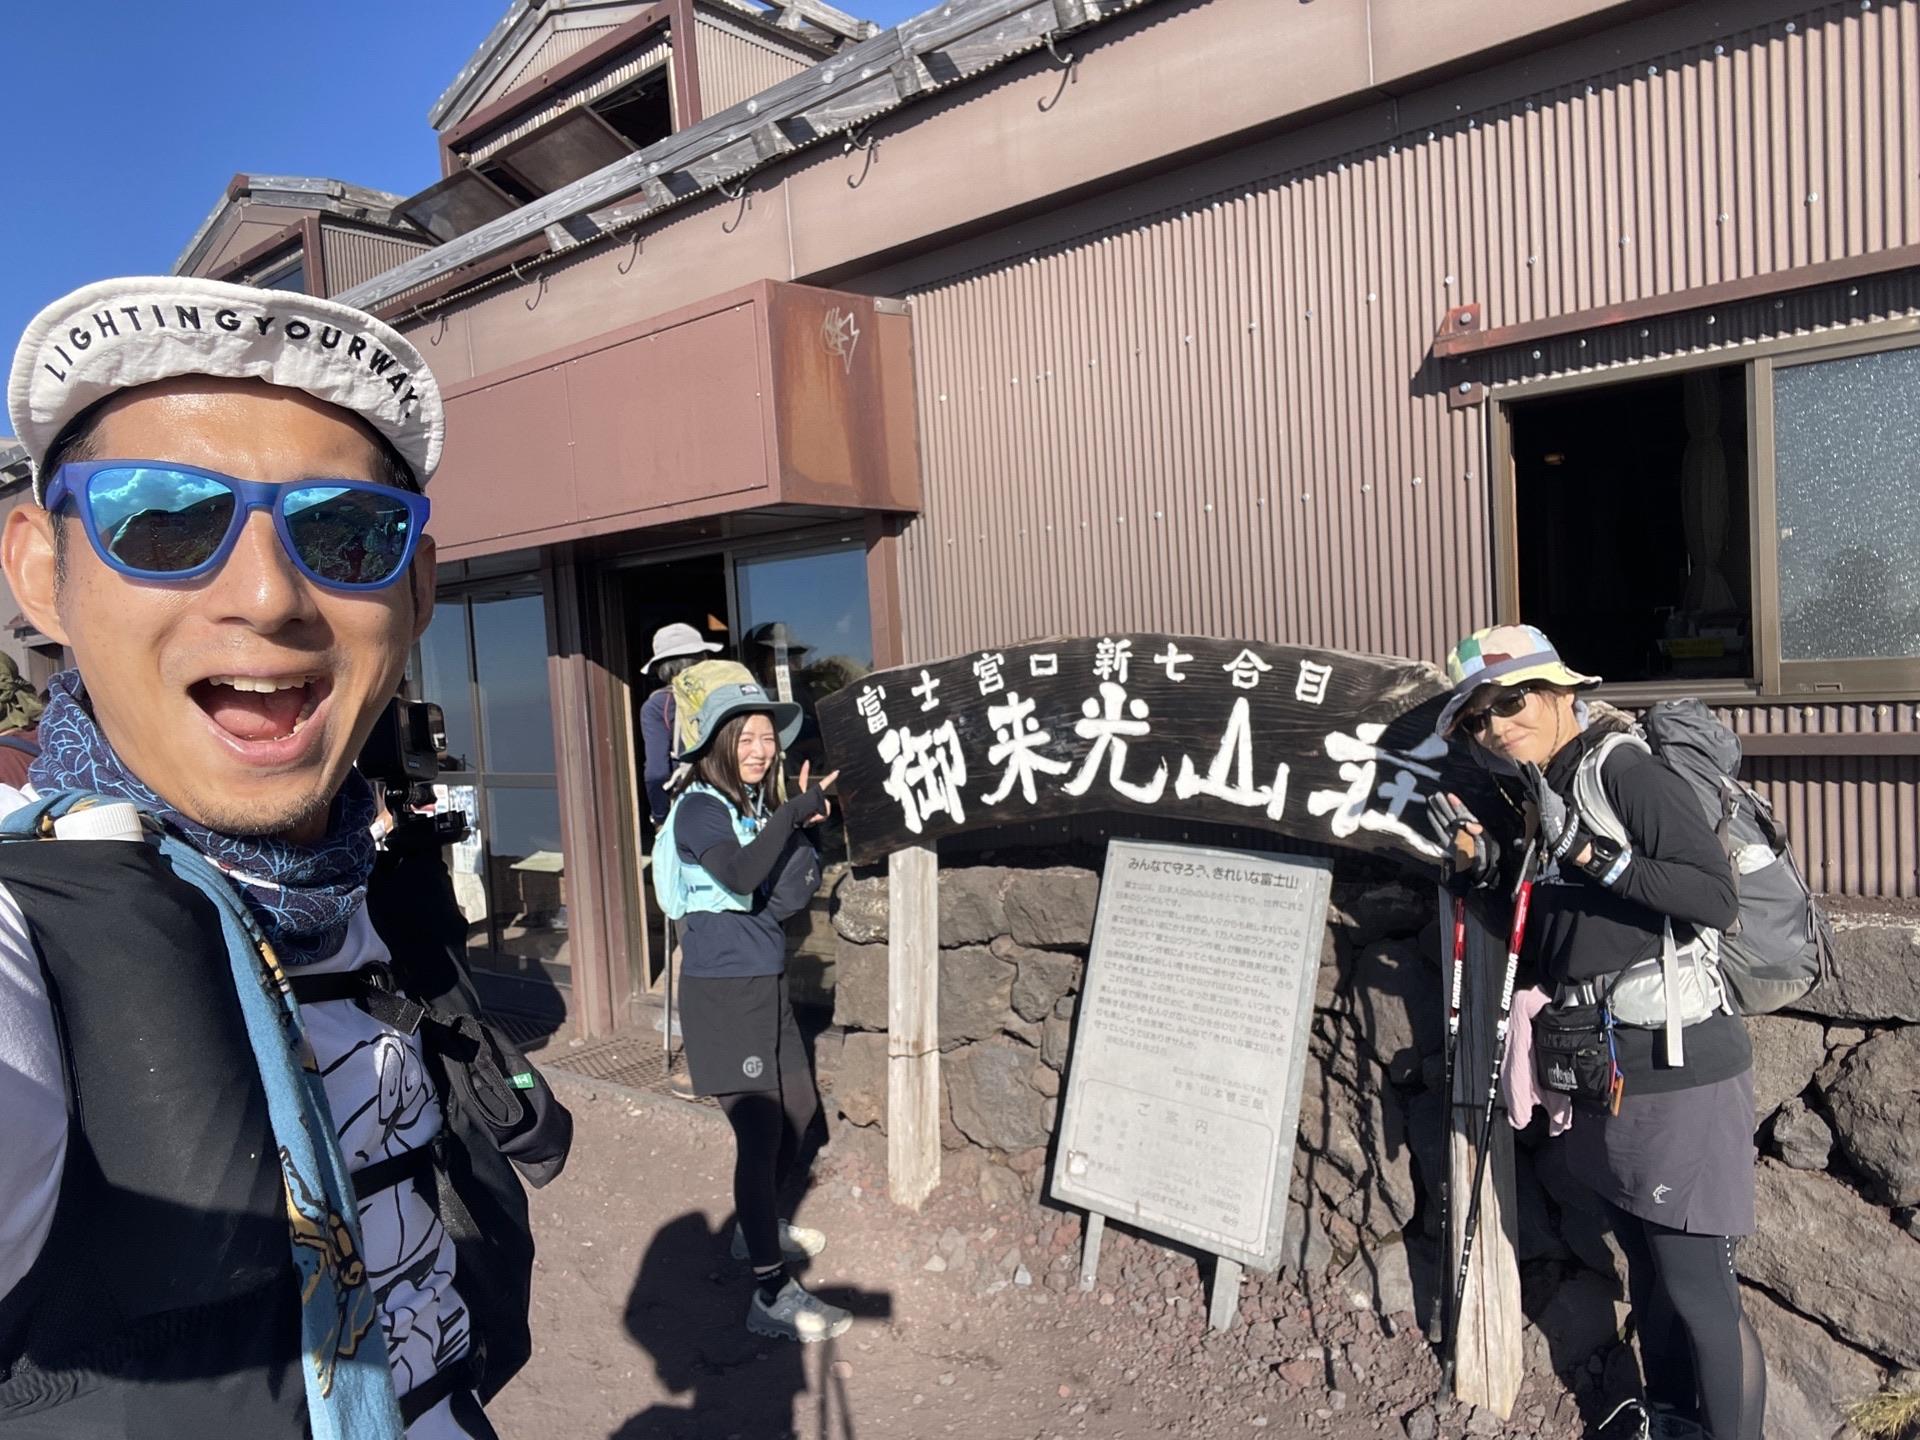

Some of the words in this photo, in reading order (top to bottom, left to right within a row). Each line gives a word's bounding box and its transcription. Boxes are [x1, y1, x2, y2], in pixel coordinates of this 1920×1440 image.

[856, 637, 1334, 735] 富士宮口新七合目
[876, 683, 1452, 856] 御来光山荘
[1127, 854, 1299, 892] みんなで守ろう、きれいな富士山
